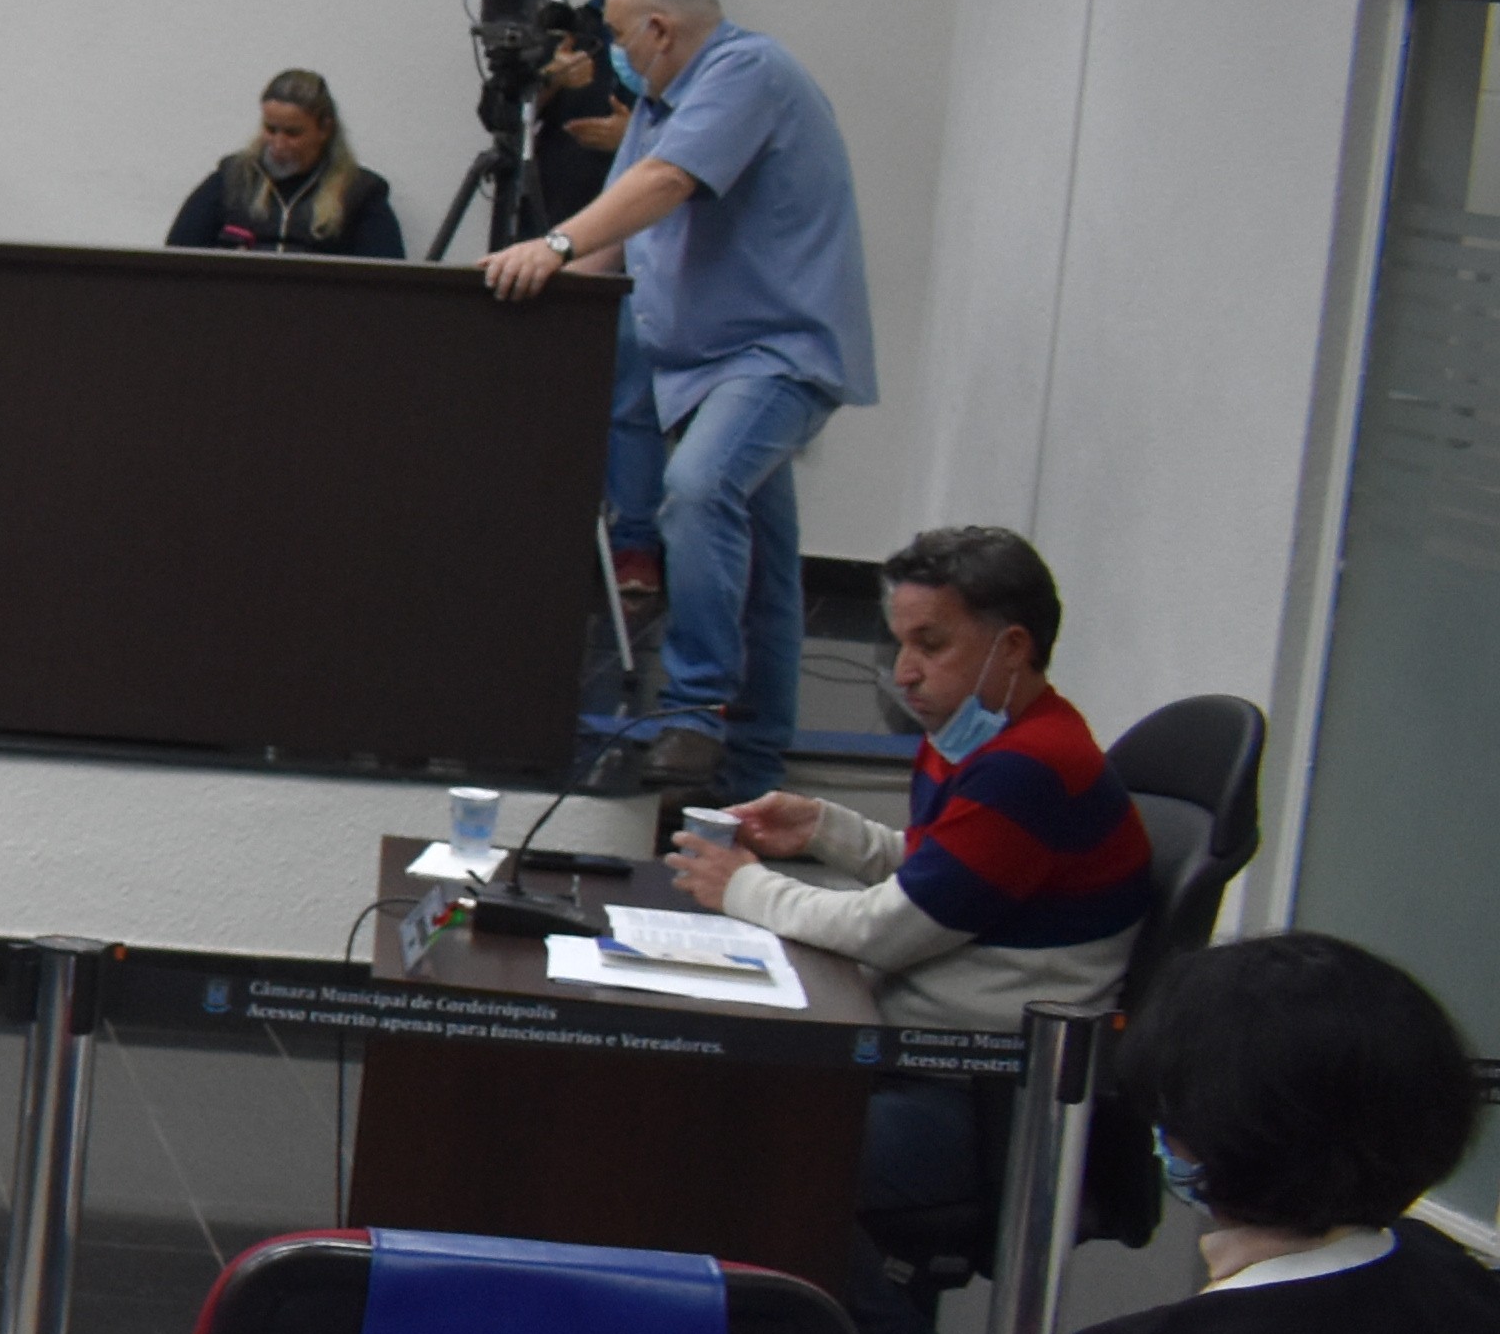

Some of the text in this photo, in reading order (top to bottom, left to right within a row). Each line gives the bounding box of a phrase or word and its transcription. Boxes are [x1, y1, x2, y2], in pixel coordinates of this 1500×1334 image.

[250, 980, 558, 1021] Câmara Municipal de Cordeirópolis
[247, 1003, 306, 1021] Acesso
[310, 1009, 377, 1027] restrito
[379, 1016, 443, 1034] apenas
[445, 1022, 488, 1038] para
[490, 1023, 604, 1047] funcionários
[605, 1035, 618, 1047] e
[900, 1030, 969, 1047] Câmara
[897, 1053, 960, 1069] Acesso
